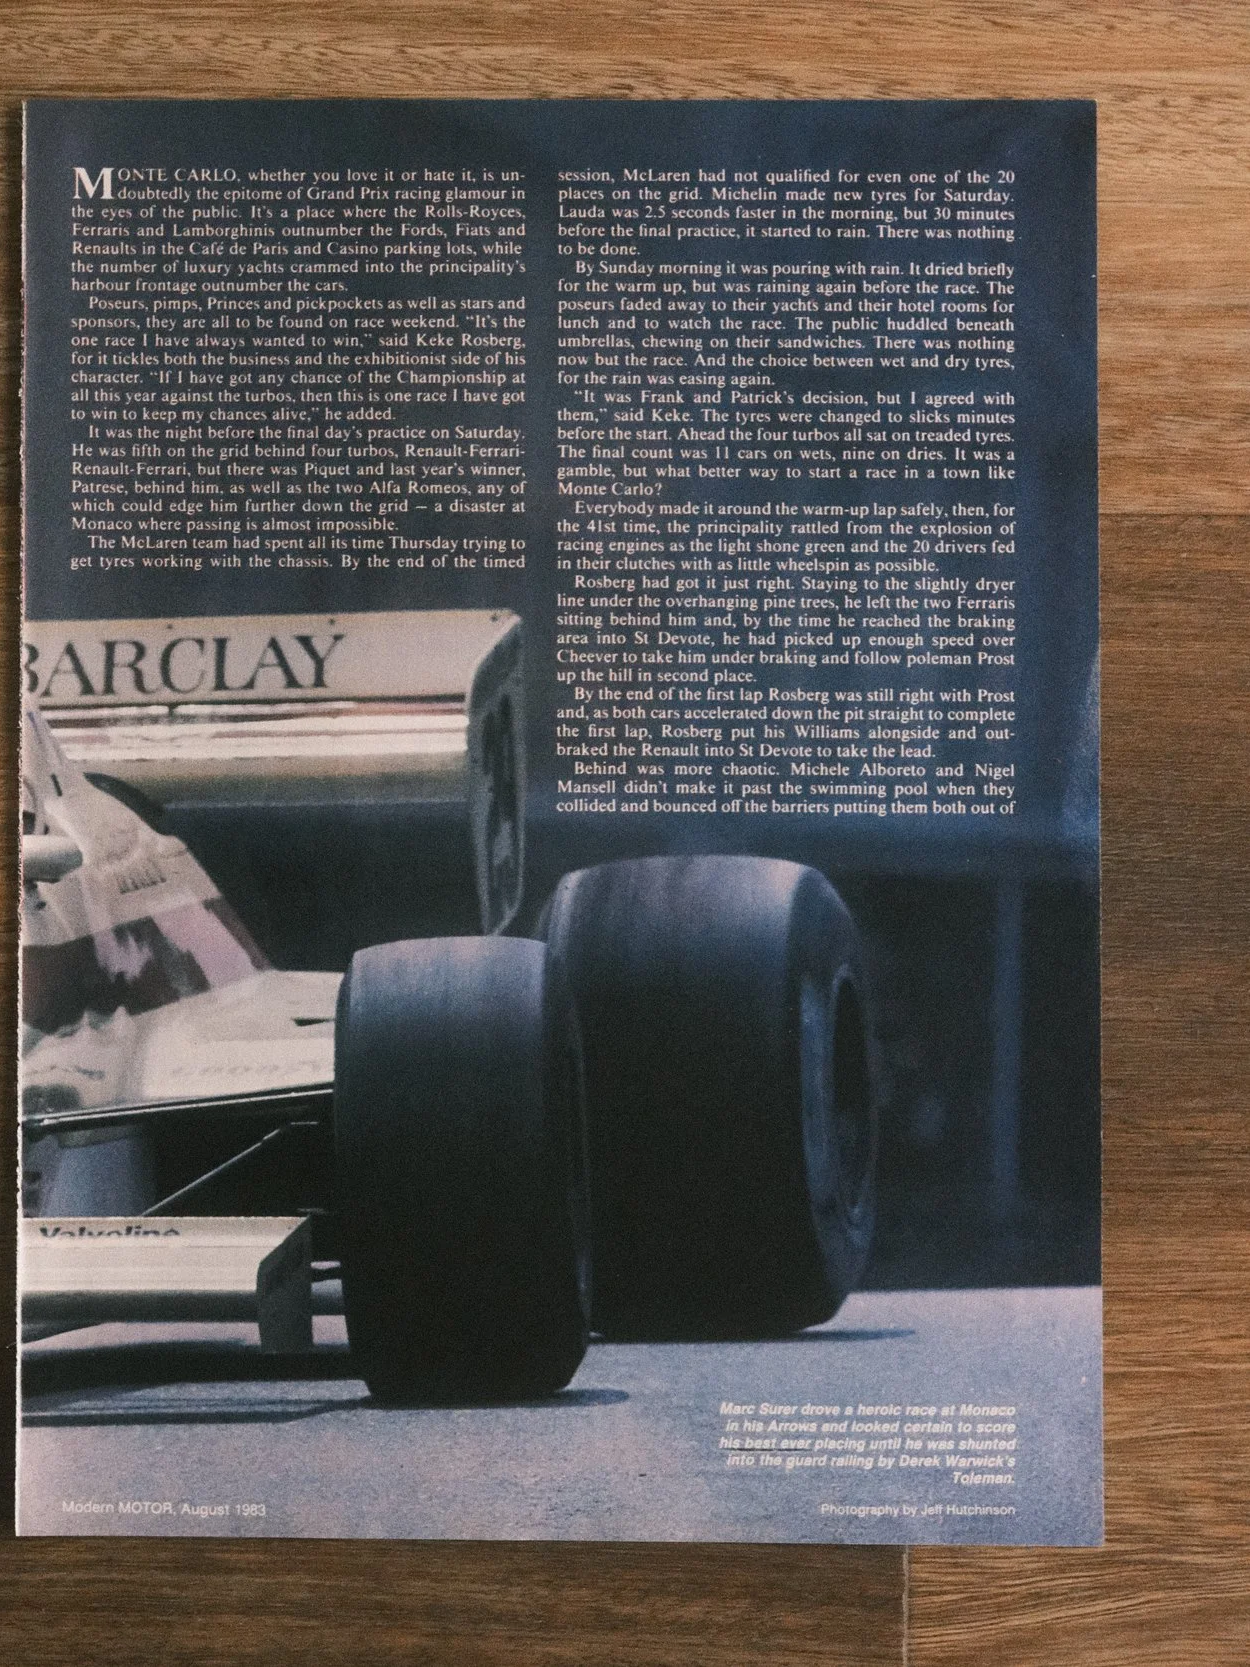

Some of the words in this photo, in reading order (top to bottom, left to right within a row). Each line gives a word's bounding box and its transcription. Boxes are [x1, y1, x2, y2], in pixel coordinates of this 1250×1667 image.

[558, 185, 605, 205] places
[611, 189, 631, 201] on
[638, 186, 665, 201] the
[668, 186, 703, 205] grid.
[711, 186, 778, 202] Michelin
[785, 187, 826, 202] made
[833, 190, 863, 202] new
[870, 189, 907, 206] tyres
[913, 187, 937, 203] for
[943, 187, 1014, 207] Saturday.
[71, 223, 130, 238] Ferraris
[136, 223, 165, 238] and
[172, 222, 276, 242] Lamborghinis
[281, 222, 363, 238] outnumber
[369, 222, 393, 237] the
[400, 222, 448, 240] Fords,
[455, 222, 492, 237] Fiats
[497, 222, 527, 237] and
[557, 333, 635, 351] umbrellas,
[641, 334, 704, 353] chewing
[709, 337, 729, 349] on
[735, 334, 771, 350] their
[777, 334, 866, 350] sandwiches.
[872, 335, 917, 350] There
[922, 338, 952, 350] was
[957, 335, 1016, 355] nothing
[70, 351, 94, 366] for
[97, 351, 108, 366] it
[112, 351, 160, 366] tickles
[163, 351, 197, 366] both
[201, 351, 225, 366] the
[229, 351, 290, 366] business
[294, 351, 323, 366] and
[327, 351, 350, 366] the
[354, 351, 447, 366] exhibitionist
[450, 351, 481, 366] side
[483, 351, 503, 366] of
[504, 351, 527, 366] his
[71, 443, 94, 458] He
[98, 446, 127, 458] was
[131, 443, 162, 458] fifth
[166, 446, 186, 458] on
[191, 443, 215, 458] the
[219, 443, 249, 462] grid
[254, 443, 306, 458] behind
[311, 443, 343, 458] four
[347, 443, 399, 461] turbos,
[404, 443, 526, 458] Renault-Ferrari-
[558, 481, 607, 496] Monte
[610, 481, 663, 496] Carlo?
[71, 516, 133, 531] Monaco
[137, 516, 182, 532] where
[186, 516, 242, 536] passing
[246, 516, 258, 532] is
[261, 516, 311, 532] almost
[316, 517, 399, 536] impossible.
[574, 760, 627, 776] Behind
[636, 764, 665, 776] was
[673, 764, 713, 776] more
[721, 761, 780, 777] chaotic.
[790, 762, 850, 777] Michele
[859, 762, 927, 778] Alboreto
[934, 762, 964, 778] and
[974, 763, 1015, 782] Nigel
[719, 1400, 756, 1416] Marc
[758, 1401, 798, 1416] Surer
[800, 1401, 841, 1416] drove
[844, 1404, 854, 1416] a
[857, 1401, 902, 1417] heroic
[905, 1405, 938, 1417] race
[940, 1403, 956, 1417] at
[959, 1402, 1017, 1417] Monaco
[724, 1418, 740, 1433] in
[742, 1418, 765, 1433] his
[766, 1418, 818, 1433] Arrows
[821, 1418, 849, 1434] and
[851, 1418, 900, 1434] looked
[903, 1418, 953, 1434] certain
[957, 1420, 973, 1434] to
[976, 1422, 1017, 1434] score
[718, 1434, 742, 1450] his
[744, 1434, 777, 1450] best
[779, 1438, 812, 1450] ever
[813, 1435, 866, 1454] placing
[869, 1435, 902, 1451] until
[904, 1435, 923, 1451] he
[927, 1439, 955, 1451] was
[958, 1436, 1018, 1451] shunted
[725, 1452, 755, 1467] into
[759, 1452, 783, 1467] the
[784, 1452, 828, 1471] guard
[830, 1452, 874, 1471] railing
[877, 1452, 896, 1471] by
[899, 1452, 940, 1468] Derek
[61, 1501, 114, 1515] Modern
[180, 1501, 230, 1518] August
[236, 1501, 267, 1515] 1983
[819, 1502, 900, 1519] Photography
[902, 1502, 918, 1519] by
[920, 1502, 944, 1516] Jeff
[945, 1502, 1016, 1516] Hutchinson
